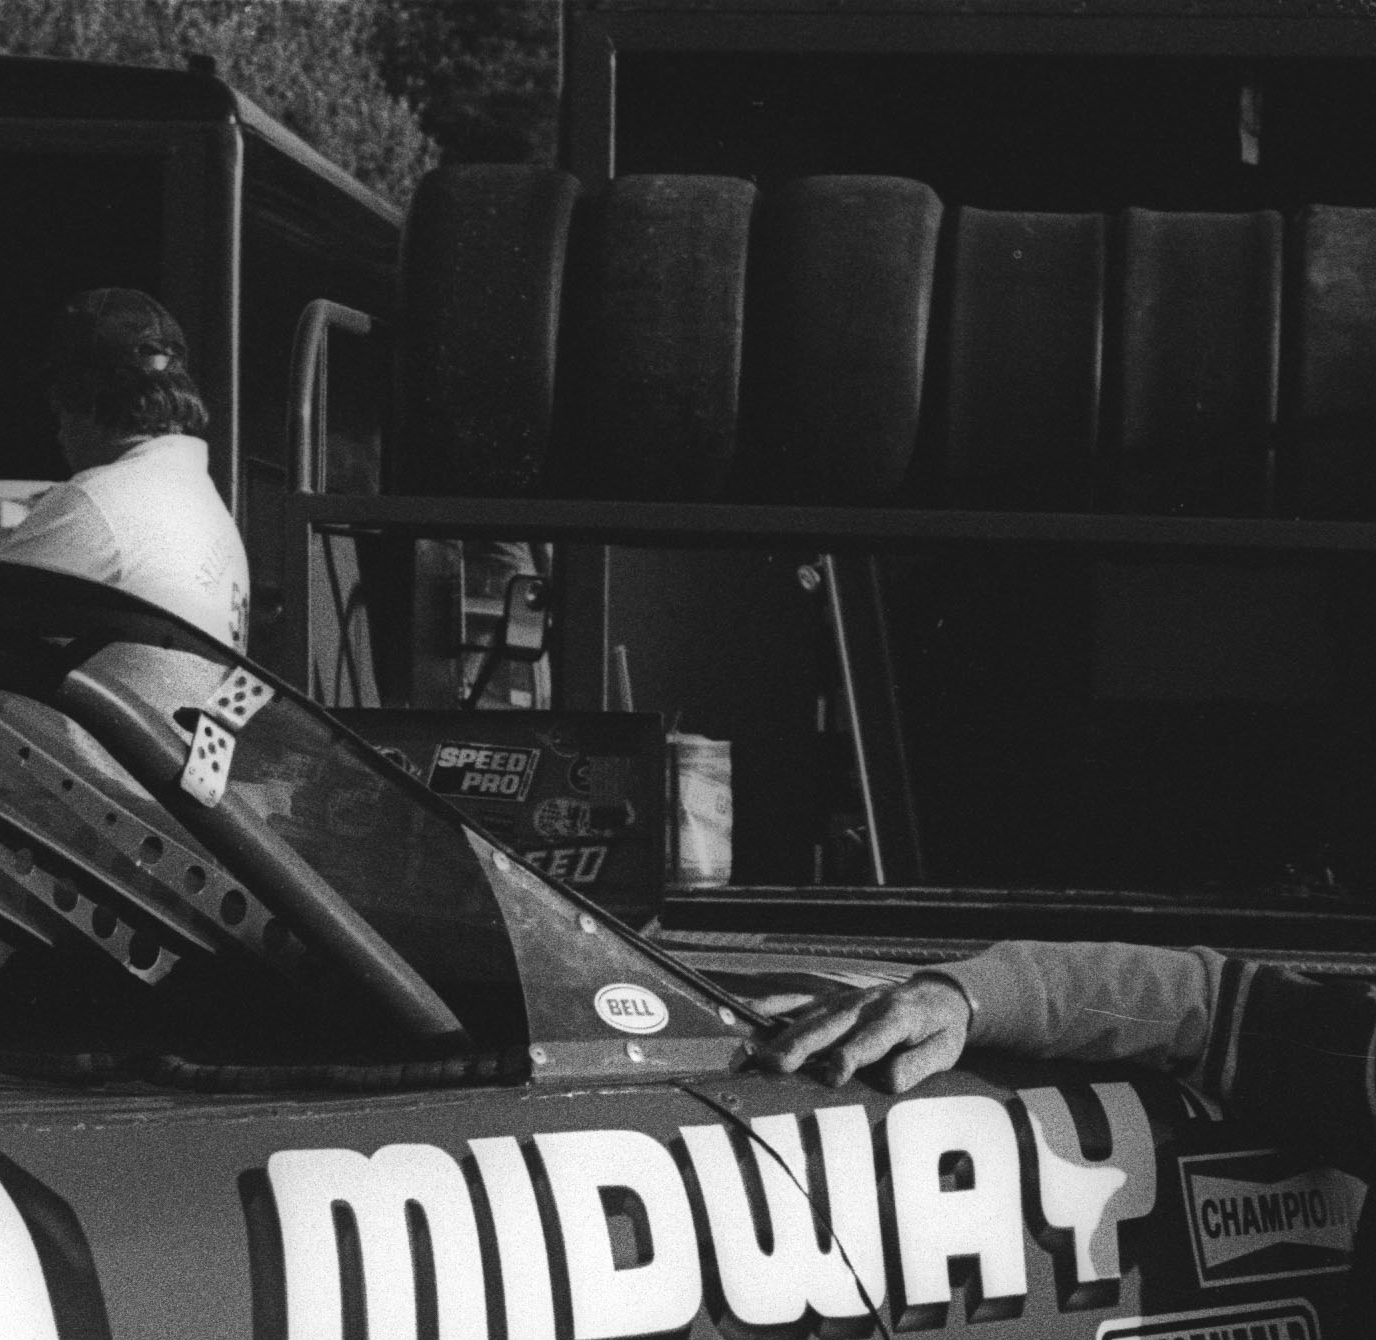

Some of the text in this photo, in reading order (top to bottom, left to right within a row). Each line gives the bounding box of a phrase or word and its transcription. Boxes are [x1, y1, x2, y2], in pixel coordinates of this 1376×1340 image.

[436, 746, 529, 773] SPEED
[460, 770, 522, 796] PRO
[605, 998, 655, 1017] BELL
[1200, 1188, 1346, 1240] CHAMPION
